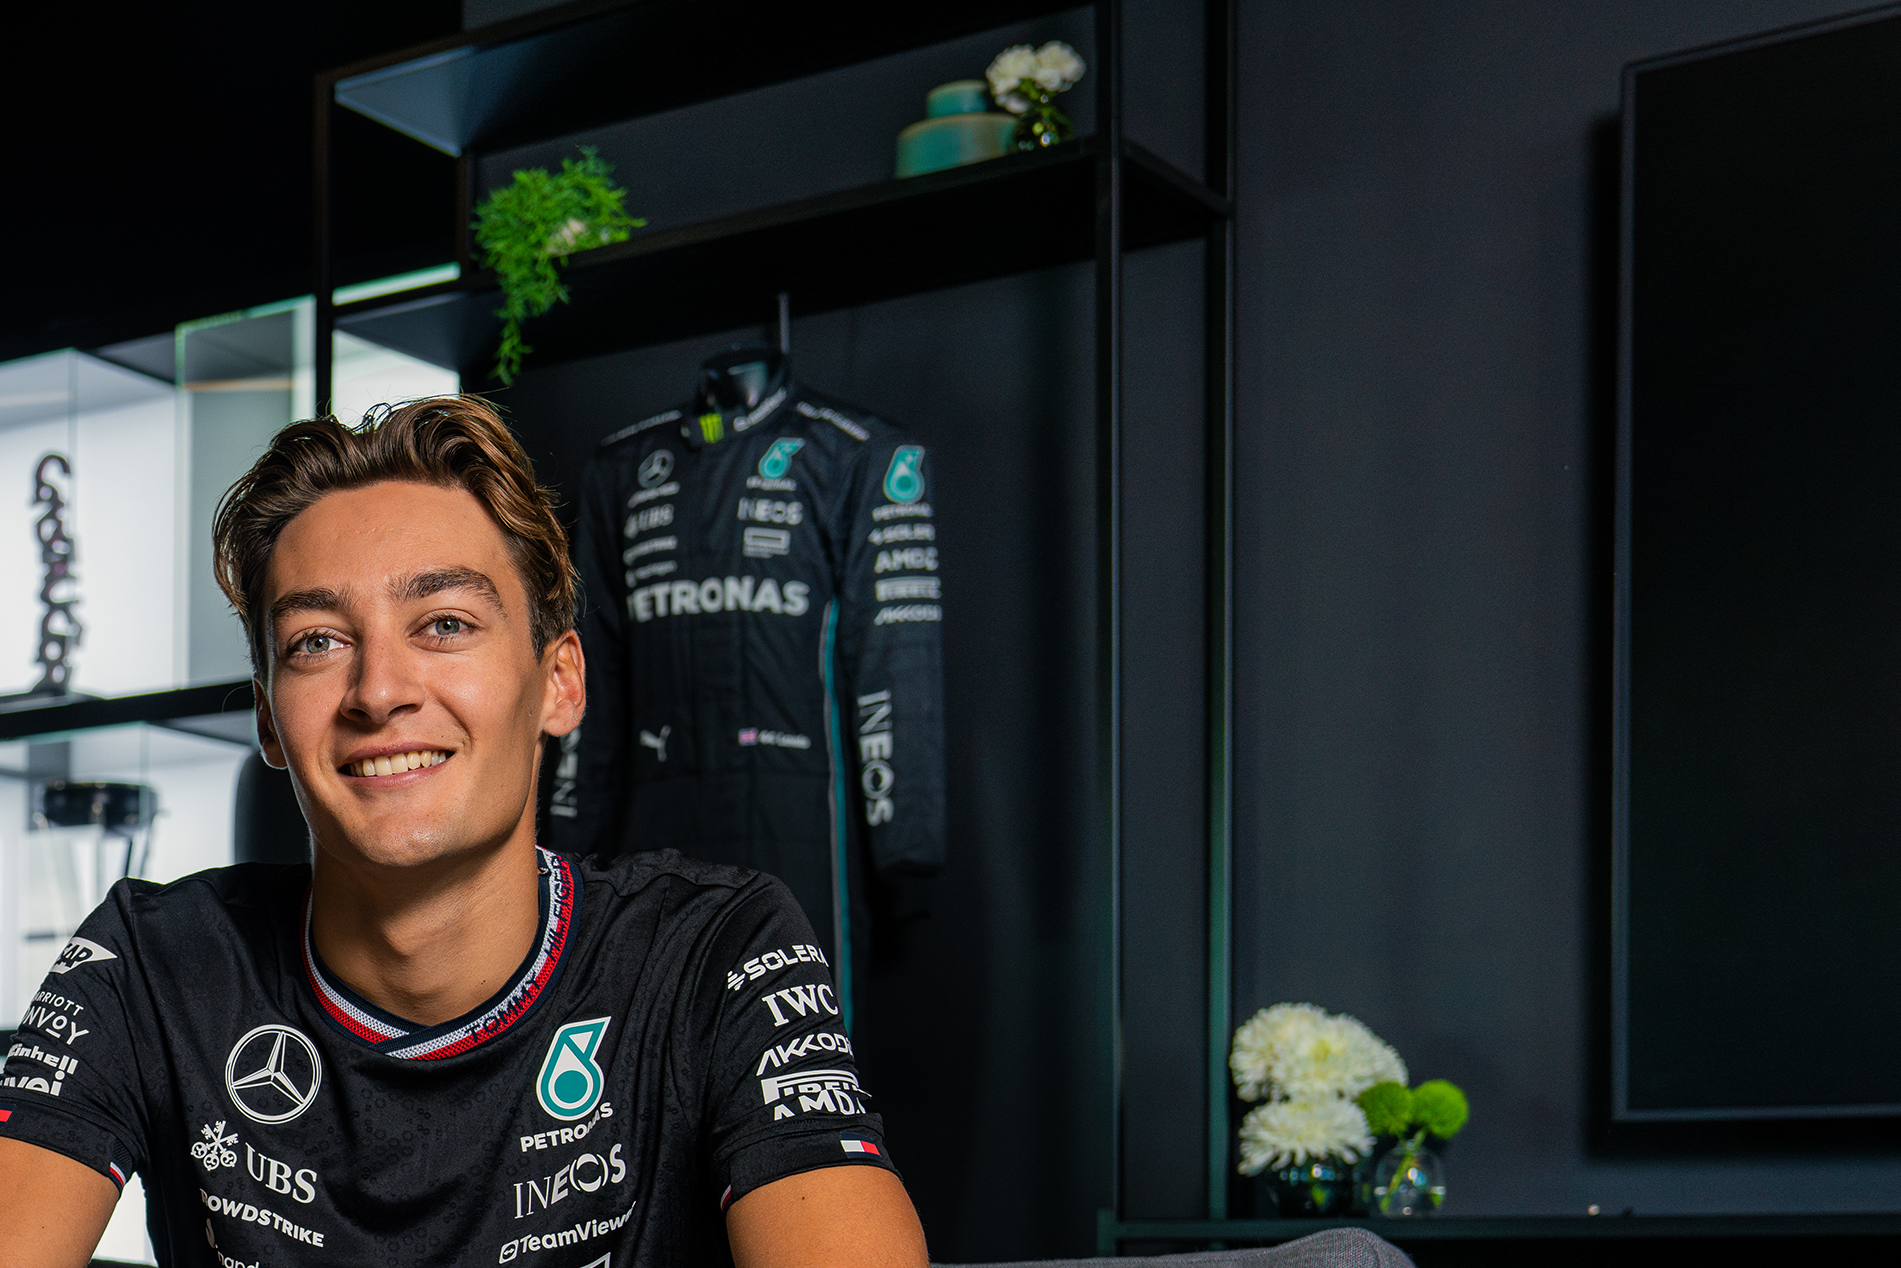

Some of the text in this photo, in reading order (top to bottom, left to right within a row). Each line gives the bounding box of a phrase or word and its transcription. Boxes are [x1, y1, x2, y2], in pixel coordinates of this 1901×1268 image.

[627, 574, 810, 623] ETRONAS
[857, 689, 895, 827] INEOS
[23, 1005, 90, 1045] NVOY
[466, 972, 541, 1042] TOMMY
[761, 983, 839, 1028] IWC
[245, 1141, 318, 1204] UBS
[513, 1143, 627, 1219] INEOS
[199, 1187, 325, 1248] ROWDSTRIKE
